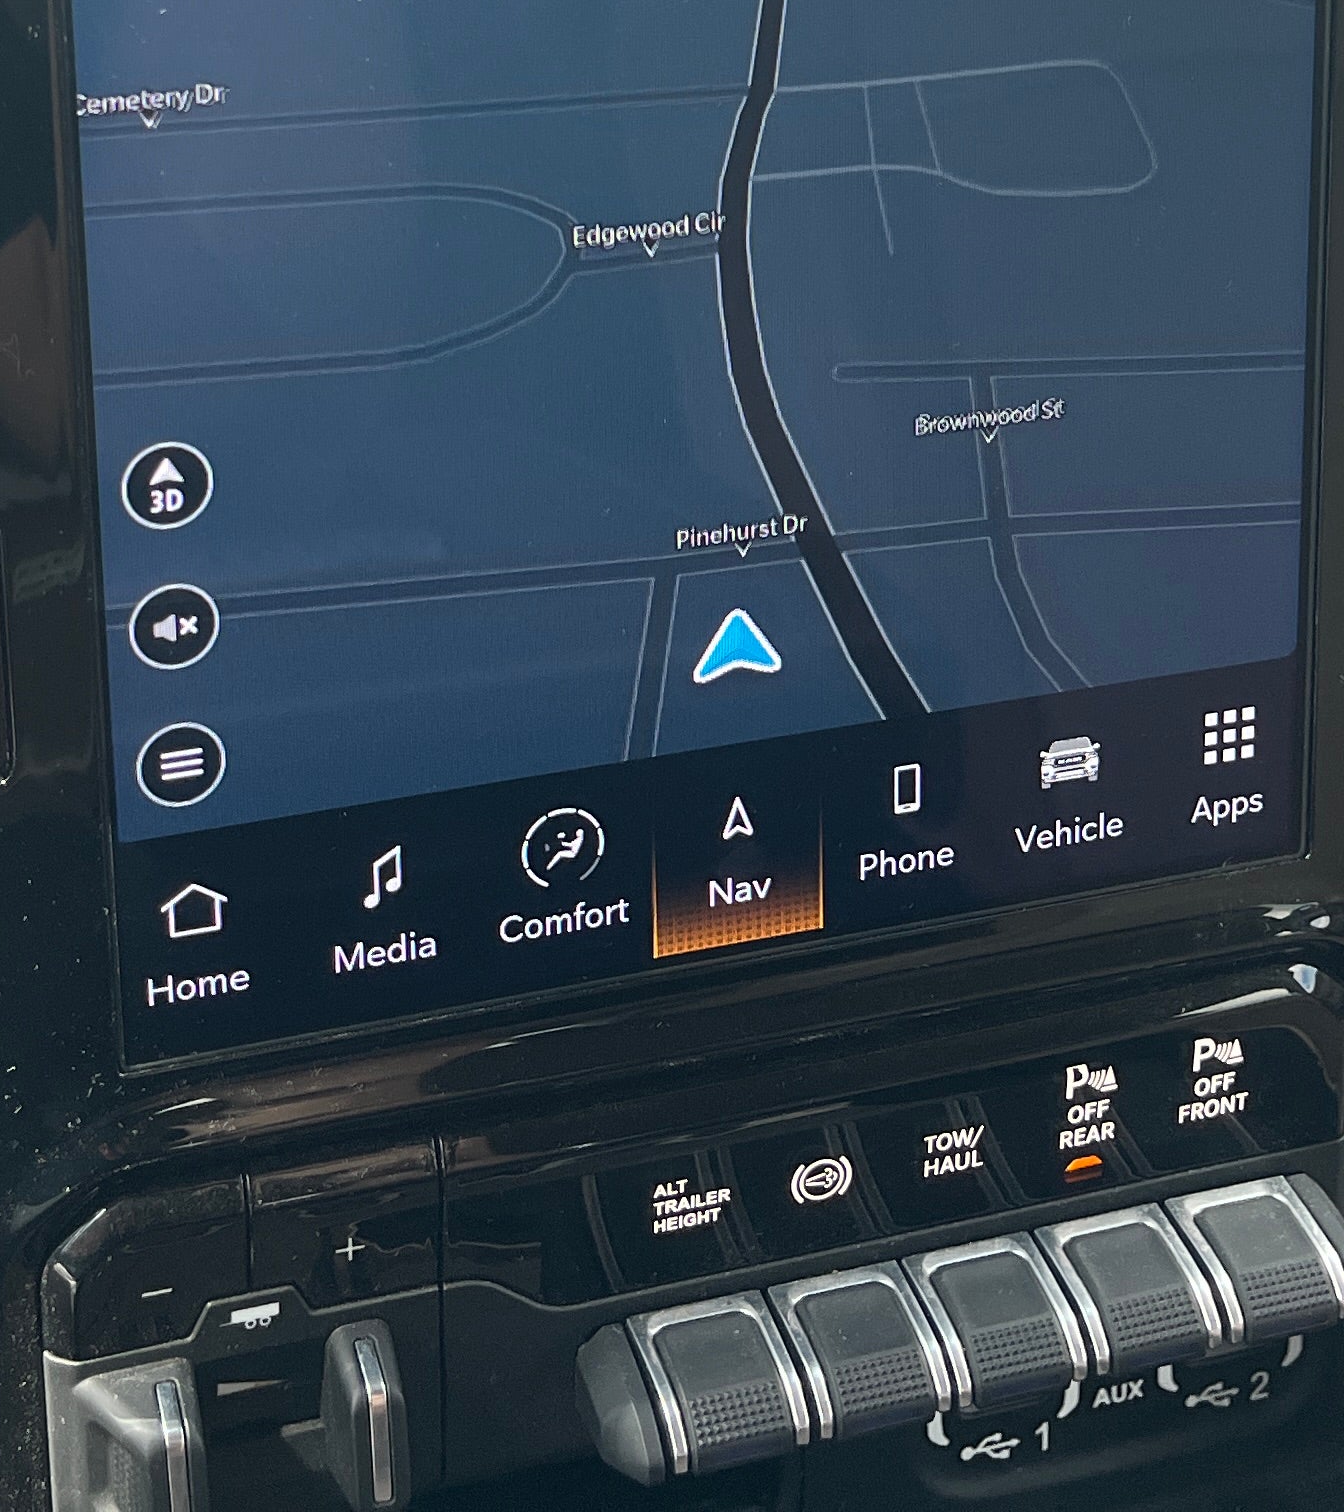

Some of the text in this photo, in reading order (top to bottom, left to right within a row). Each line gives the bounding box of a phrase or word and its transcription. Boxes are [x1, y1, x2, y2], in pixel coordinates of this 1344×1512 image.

[76, 83, 230, 117] Cemetery Dr
[573, 214, 690, 249] Edgewood
[915, 397, 1066, 436] Brownwood St
[150, 488, 185, 514] 3D
[676, 514, 809, 550] Pinehurst Dr
[1190, 791, 1265, 826] Apps
[1014, 811, 1125, 854] Vehicle
[858, 844, 956, 881] Phone
[708, 876, 773, 908] Nav
[498, 897, 631, 944] Comfort
[332, 930, 439, 975] Media
[145, 966, 252, 1008] Home
[1194, 1072, 1236, 1098] OFF
[1067, 1099, 1111, 1125] OFF
[1178, 1092, 1249, 1124] FRONT
[923, 1124, 986, 1155] TOW/
[1058, 1121, 1116, 1150] REAR
[922, 1151, 984, 1178] HAUL
[652, 1178, 689, 1199] ALT
[652, 1187, 732, 1218] TRAILER
[652, 1207, 722, 1235] HEIGHT
[1091, 1378, 1146, 1409] AUX
[1250, 1371, 1271, 1401] 2
[1034, 1420, 1051, 1452] 1
